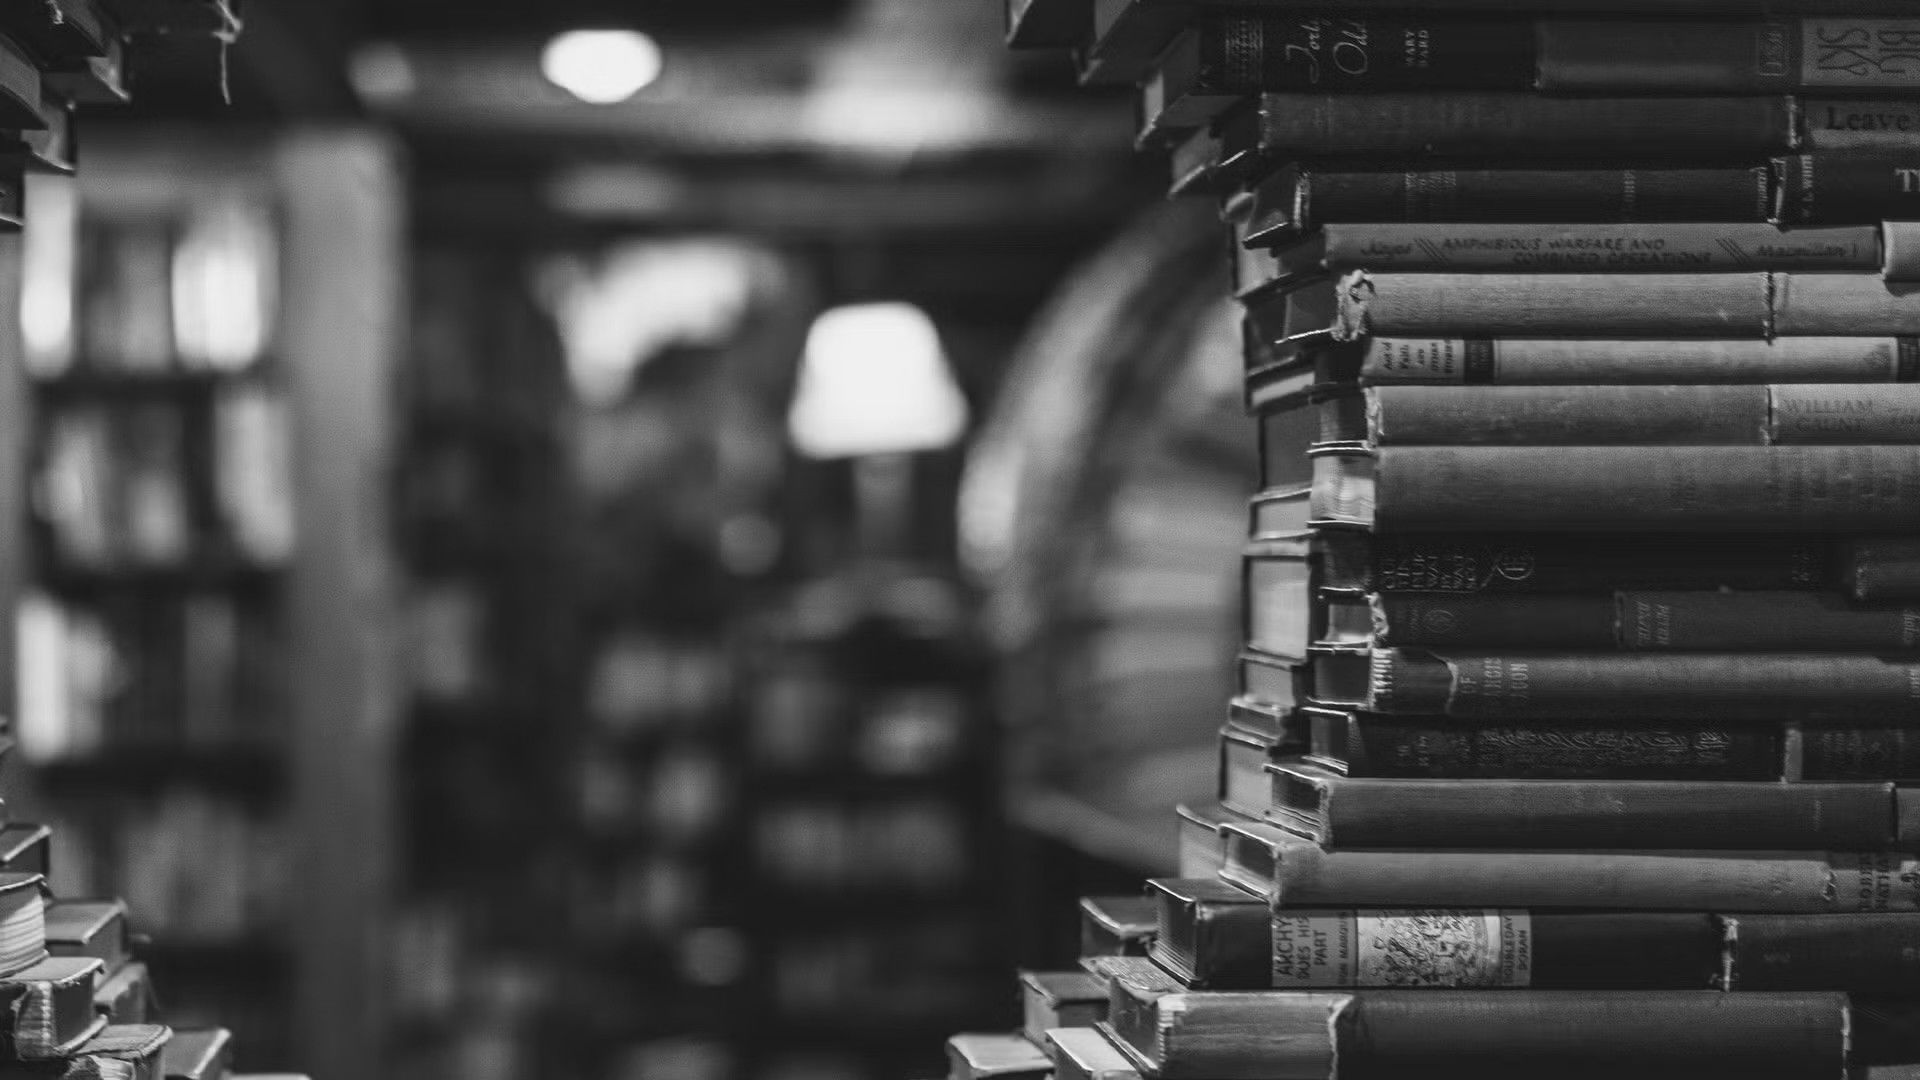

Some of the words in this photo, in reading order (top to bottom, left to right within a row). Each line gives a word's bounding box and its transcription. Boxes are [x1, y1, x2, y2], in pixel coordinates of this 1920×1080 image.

[1815, 26, 1876, 77] SKY
[1826, 106, 1911, 131] Leave
[1442, 238, 1540, 251] AMPHIBIOUS
[1548, 238, 1623, 251] WARFARE
[1630, 238, 1665, 251] AND
[1512, 252, 1601, 266] COMBINED
[1607, 252, 1712, 266] OPERATIONS
[1783, 399, 1874, 414] WILLIAM
[1296, 913, 1311, 938] HIS
[1275, 917, 1294, 977] ARCHY
[1313, 929, 1328, 966] PART
[1296, 945, 1311, 980] DOES
